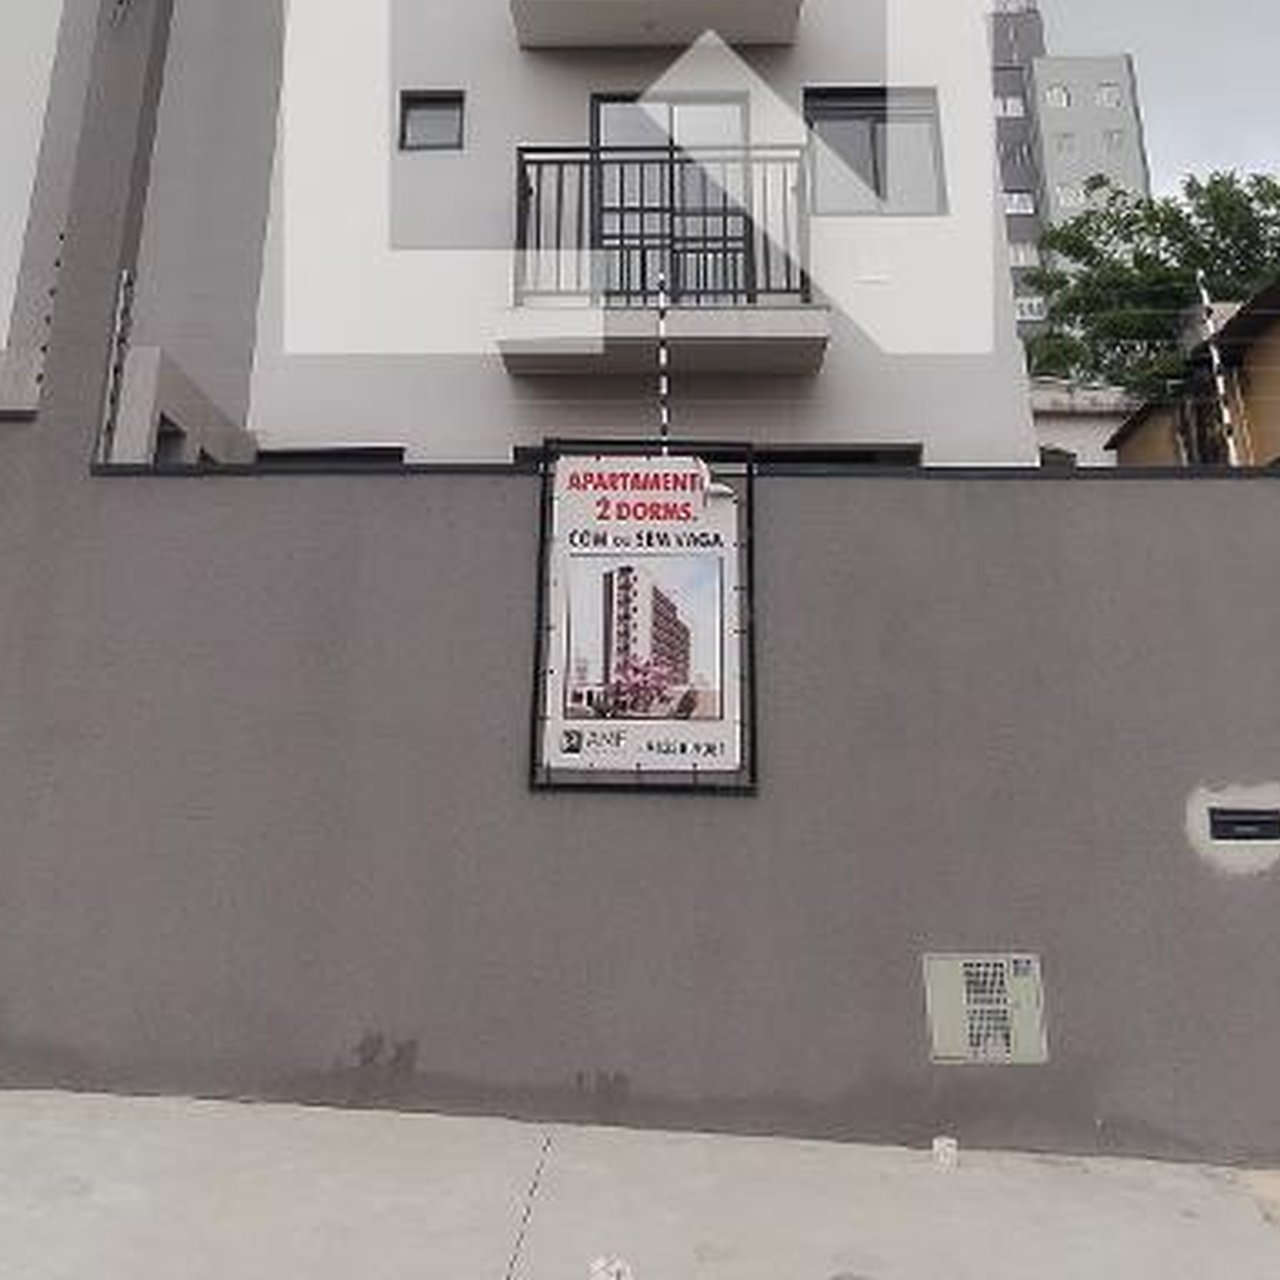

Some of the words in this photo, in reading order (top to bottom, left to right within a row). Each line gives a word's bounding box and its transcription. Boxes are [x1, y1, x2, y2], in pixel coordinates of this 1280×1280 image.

[596, 497, 610, 521] 2
[616, 501, 698, 522] DORMS.
[569, 529, 608, 547] COM
